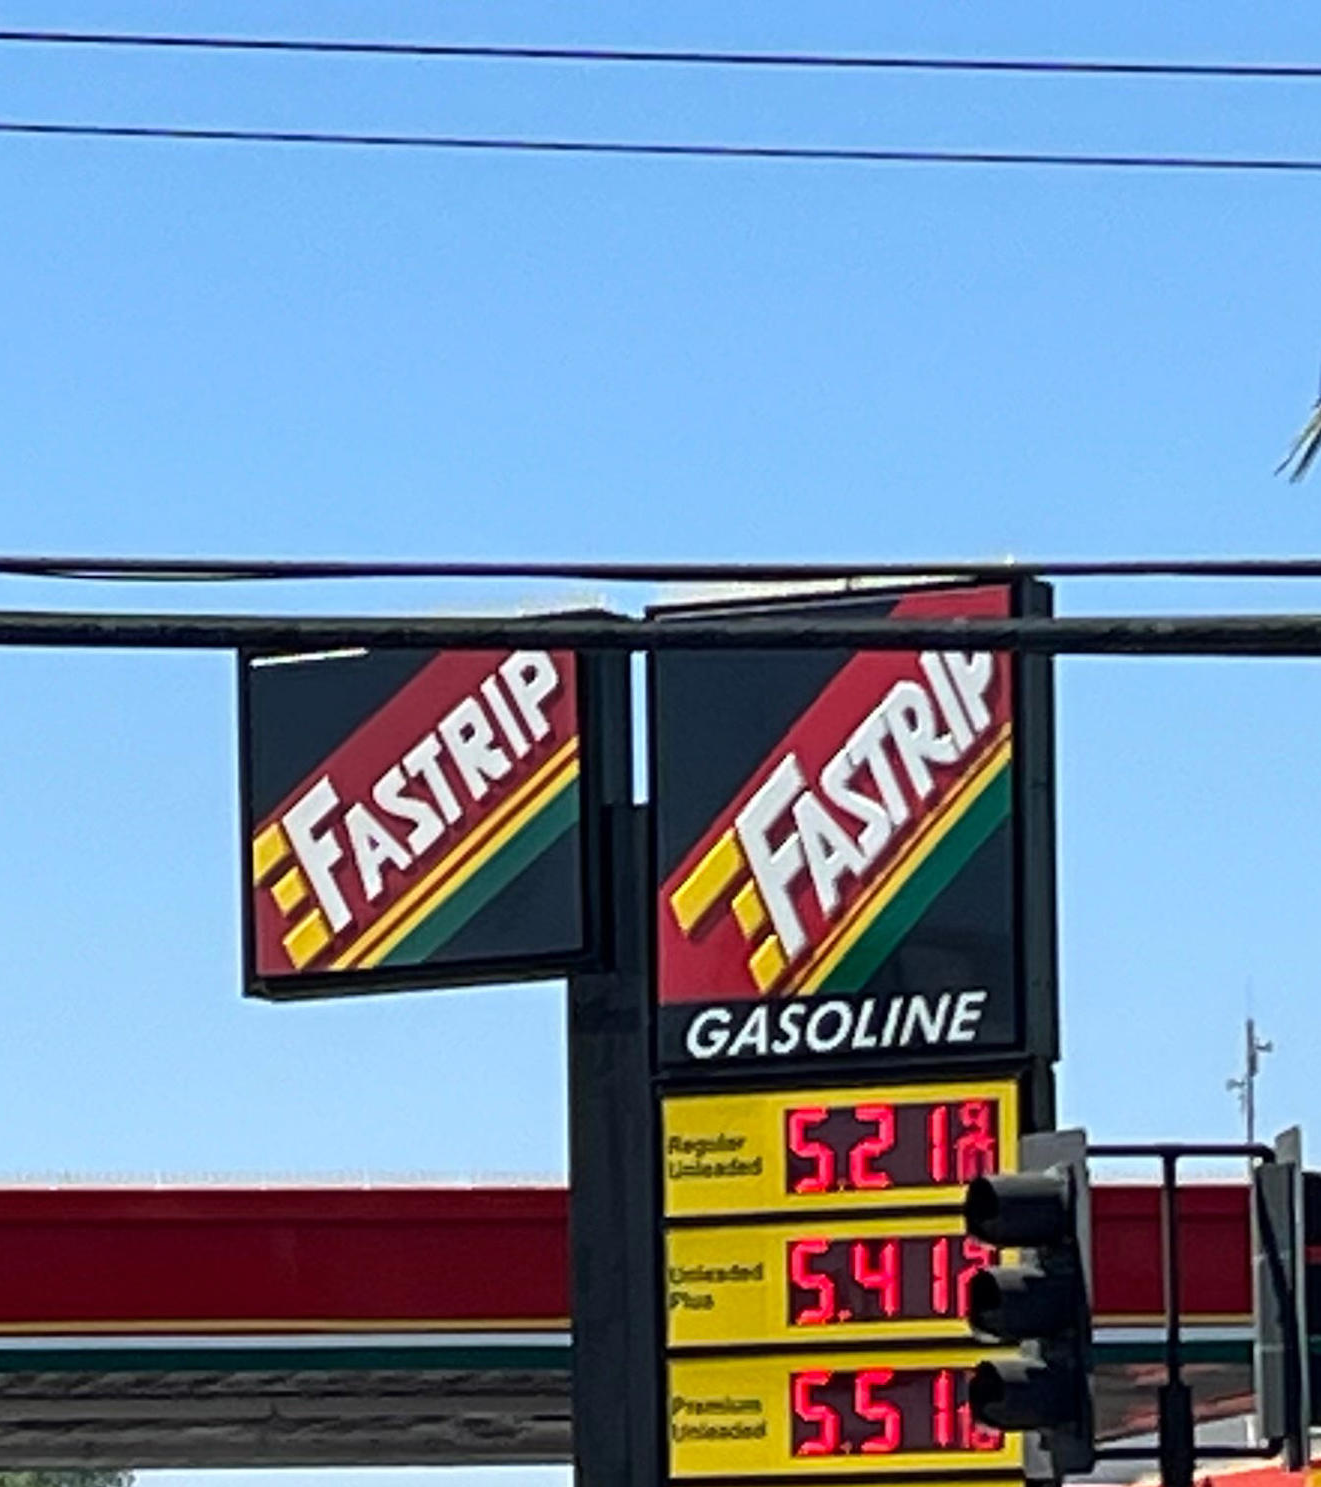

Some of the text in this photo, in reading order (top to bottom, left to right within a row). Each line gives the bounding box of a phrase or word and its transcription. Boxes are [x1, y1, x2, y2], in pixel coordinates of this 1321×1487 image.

[283, 650, 560, 932] FASTRIP
[736, 650, 993, 962] FASTRIP
[686, 991, 988, 1059] GASOLINE
[668, 1133, 745, 1157] Regular
[669, 1157, 763, 1178] Unleaded
[669, 1263, 763, 1283] Unleaded
[670, 1292, 714, 1310] Plus
[672, 1397, 762, 1415] Premium
[672, 1420, 767, 1441] Unleaded
